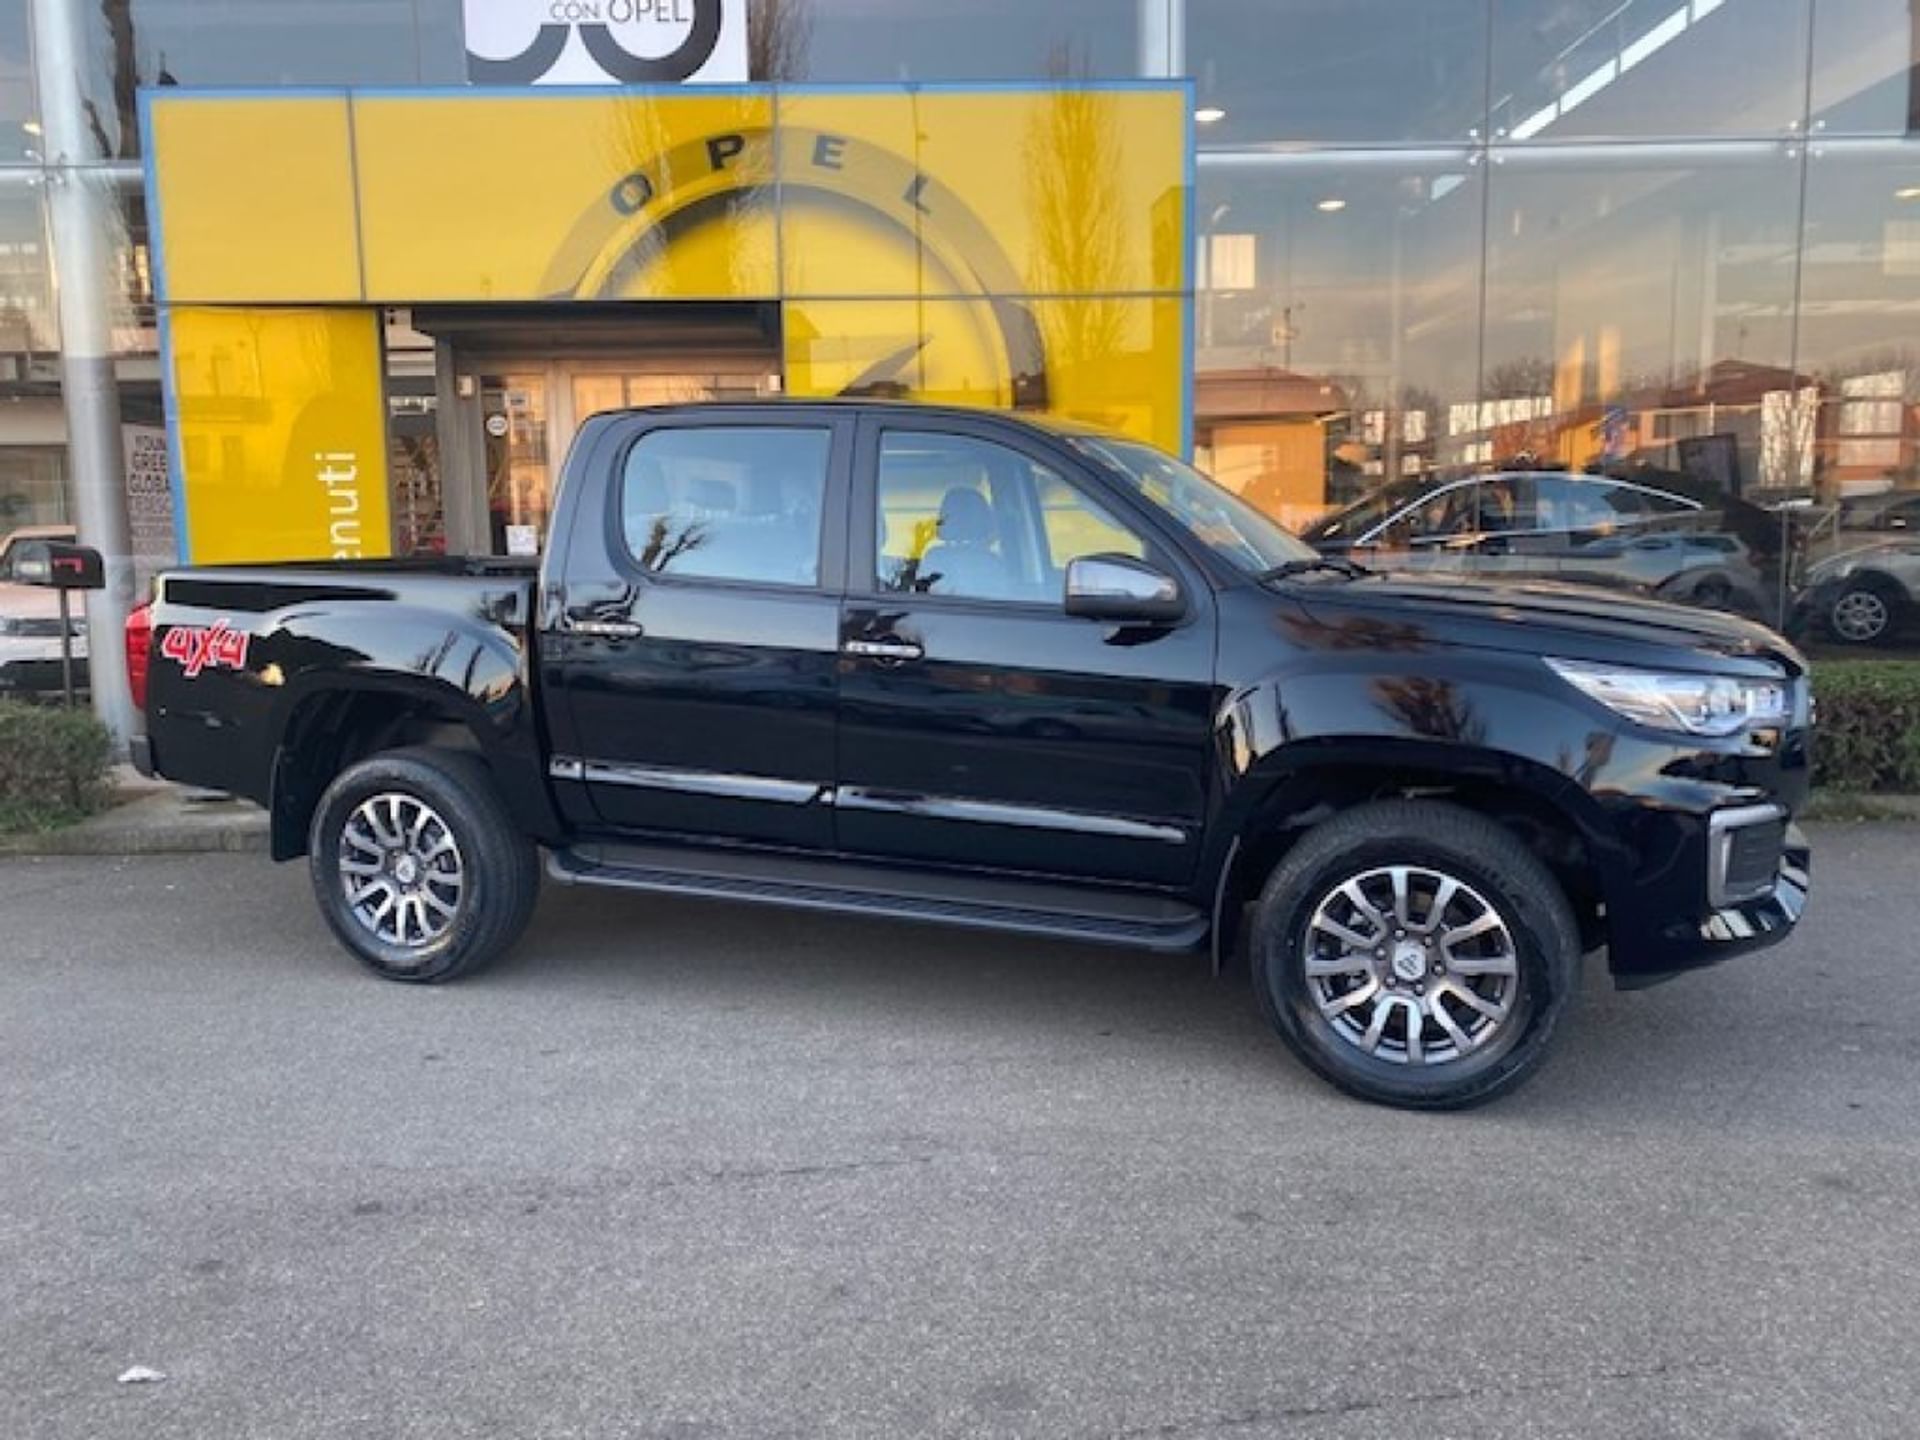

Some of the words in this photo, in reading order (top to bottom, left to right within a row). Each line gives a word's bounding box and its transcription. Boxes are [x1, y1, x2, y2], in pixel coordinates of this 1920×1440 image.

[549, 1, 600, 20] CON
[609, 0, 691, 23] OPEL
[609, 134, 932, 217] OPEL
